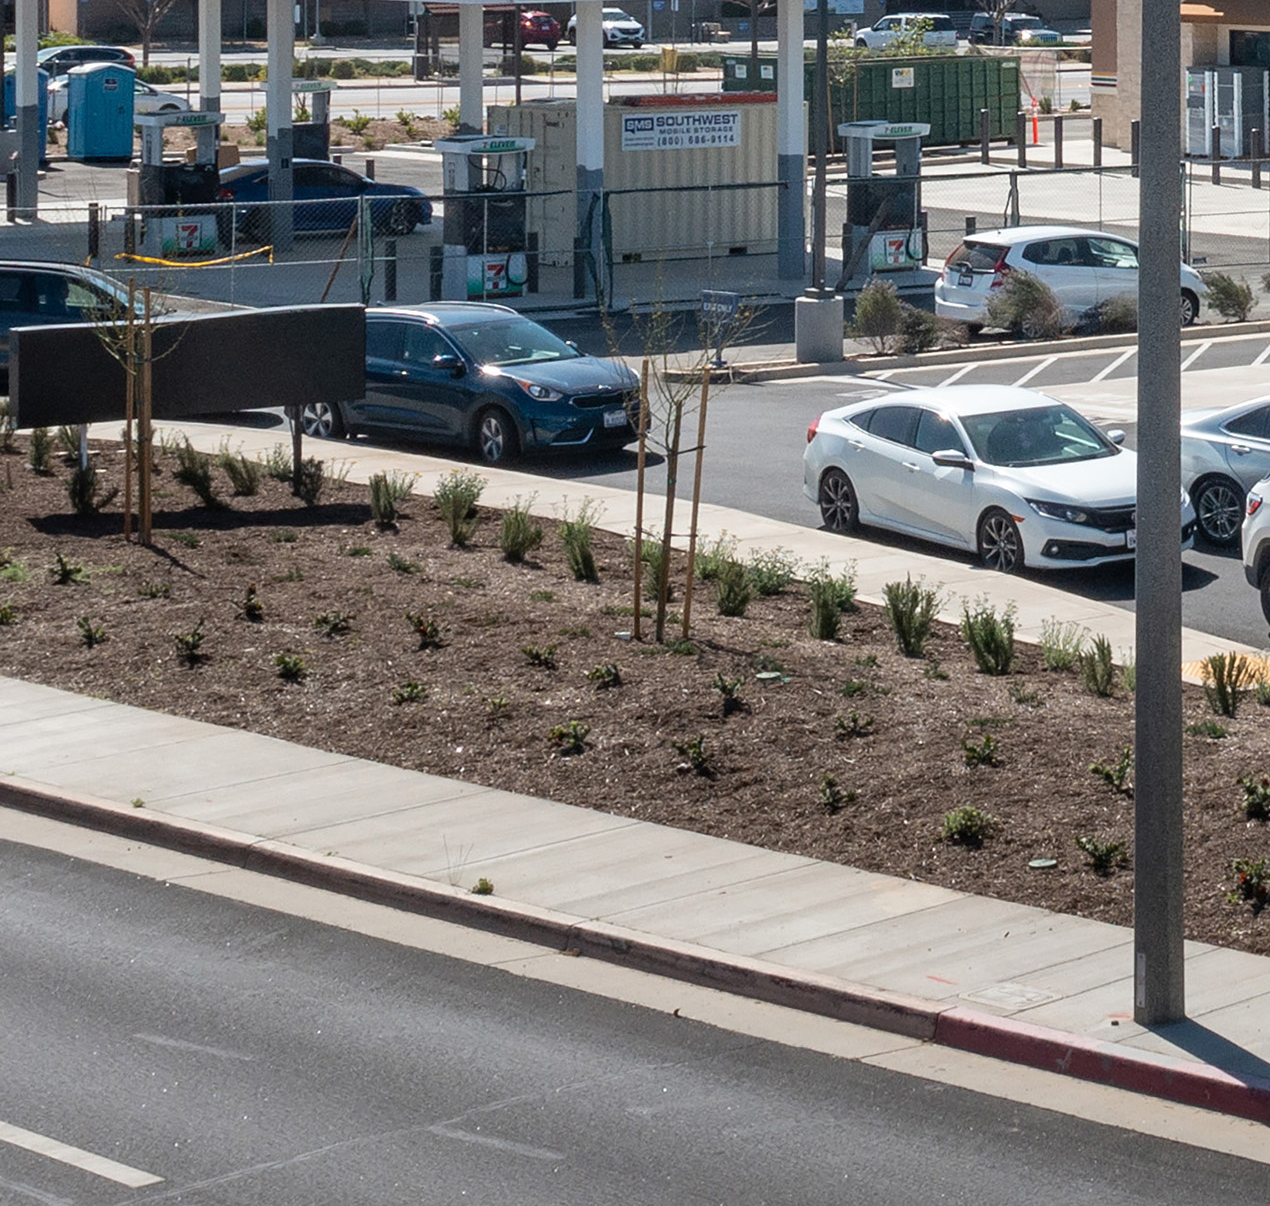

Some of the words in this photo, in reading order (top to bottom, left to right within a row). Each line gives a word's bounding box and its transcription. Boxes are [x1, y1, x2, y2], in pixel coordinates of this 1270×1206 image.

[656, 114, 738, 127] SOUTHWEST
[660, 127, 691, 135] MOBILE
[694, 126, 734, 134] STORAGE
[657, 136, 684, 147] (800)
